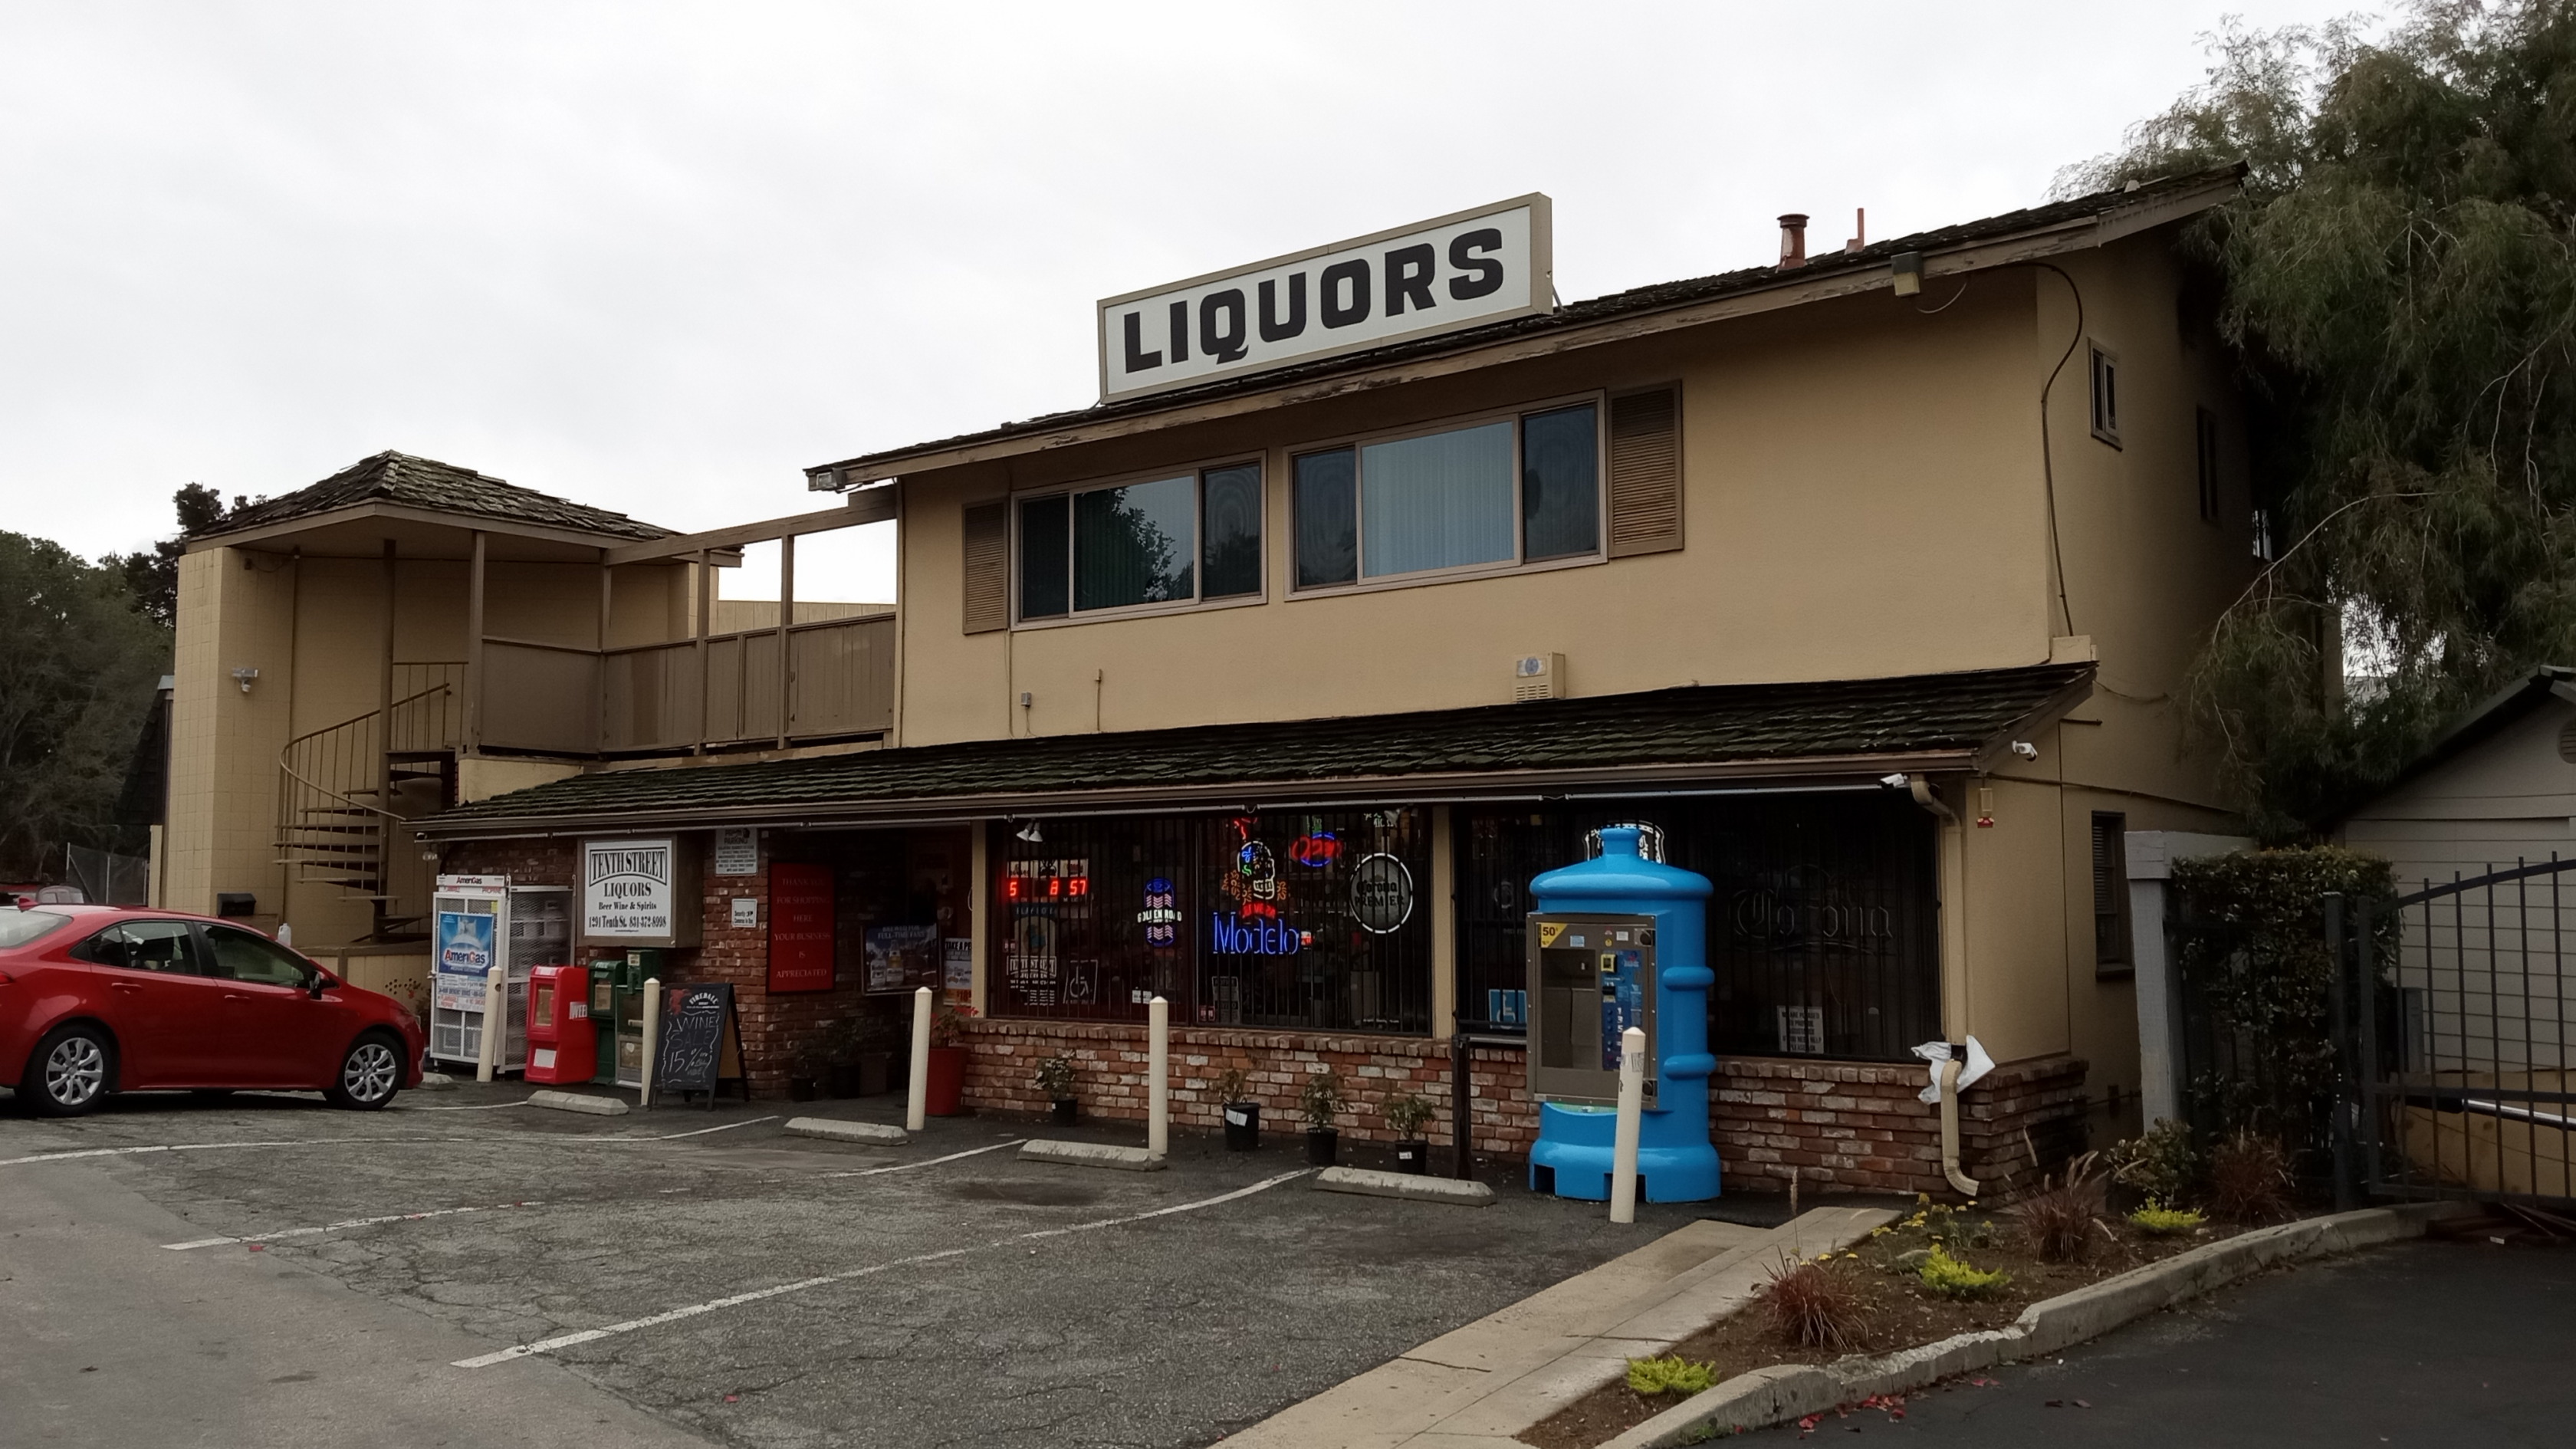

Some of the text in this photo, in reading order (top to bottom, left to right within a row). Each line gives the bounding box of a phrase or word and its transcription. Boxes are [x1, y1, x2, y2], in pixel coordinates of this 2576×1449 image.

[1123, 228, 1504, 374] LIQUORS
[592, 851, 665, 881] TENTH STREET
[781, 878, 808, 886] THANK
[604, 882, 652, 899] LIQUORS
[599, 902, 657, 911] Beer Wine & Spirits
[776, 896, 791, 905] FOR
[1355, 895, 1405, 906] PREMER
[602, 915, 619, 928] Tenth
[1165, 909, 1182, 922] ROD
[774, 932, 831, 941] YOUR BUSINESS
[1213, 911, 1300, 955] Modelo
[445, 949, 485, 964] AmeriGas
[798, 951, 806, 959] IS
[776, 968, 827, 978] APPRECIATED
[677, 1017, 716, 1032] WINE
[669, 1030, 711, 1049] SALE
